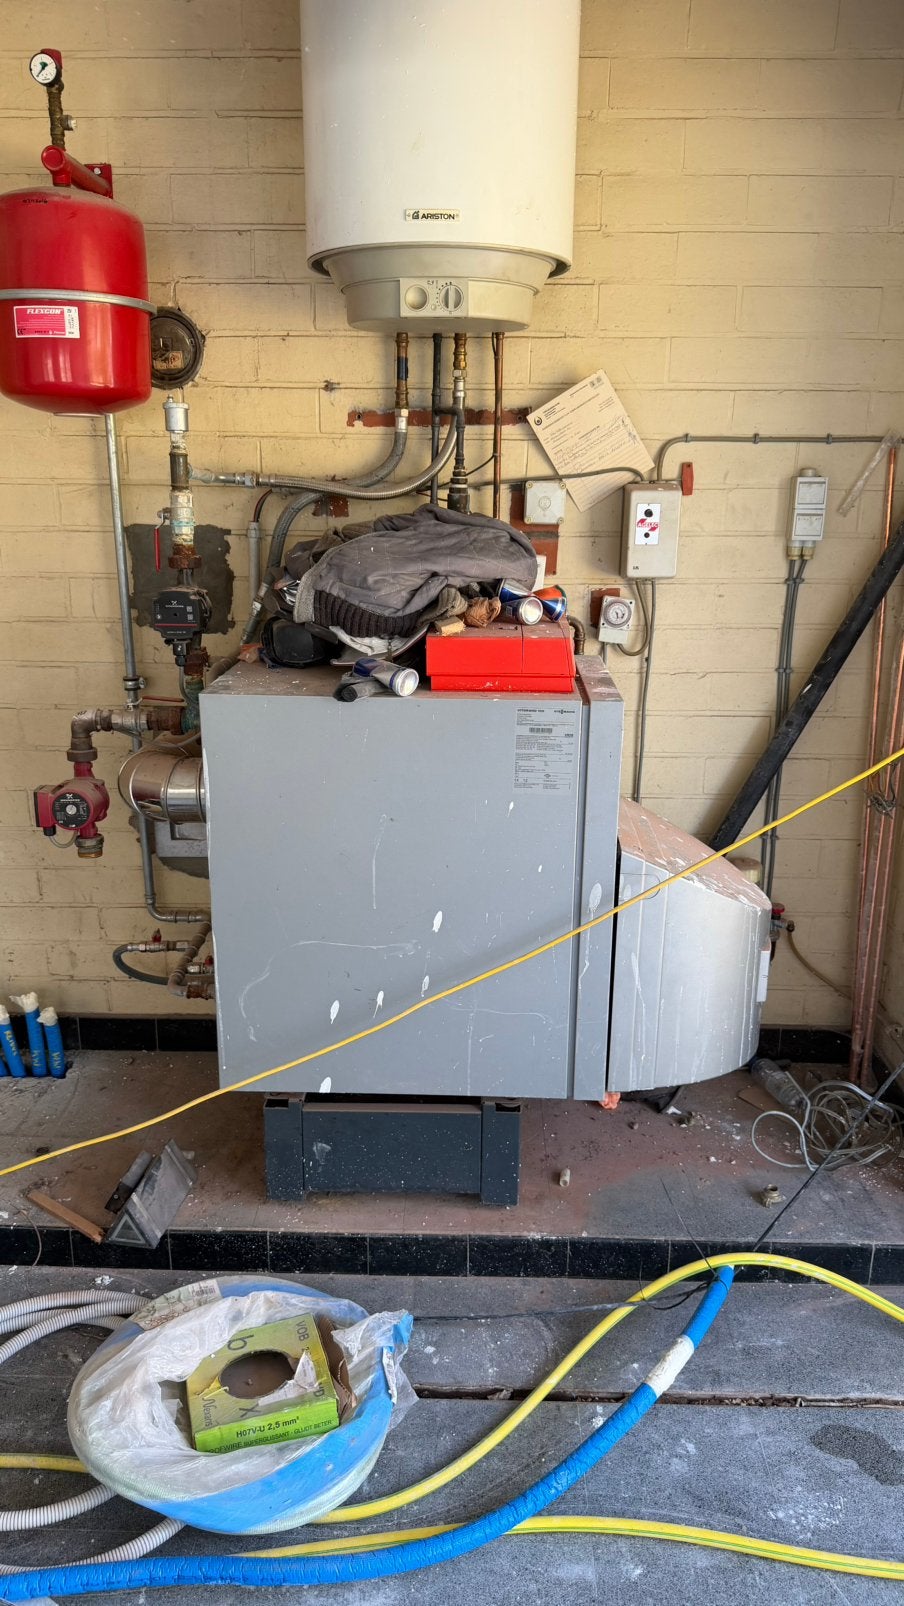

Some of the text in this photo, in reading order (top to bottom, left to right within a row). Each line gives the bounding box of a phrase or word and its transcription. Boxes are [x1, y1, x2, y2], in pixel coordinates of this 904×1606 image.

[296, 1320, 309, 1341] VOB
[201, 1397, 217, 1427] Nexans
[236, 1425, 266, 1438] H07V-U
[267, 1420, 281, 1431] 2,5
[314, 1420, 332, 1429] BETER
